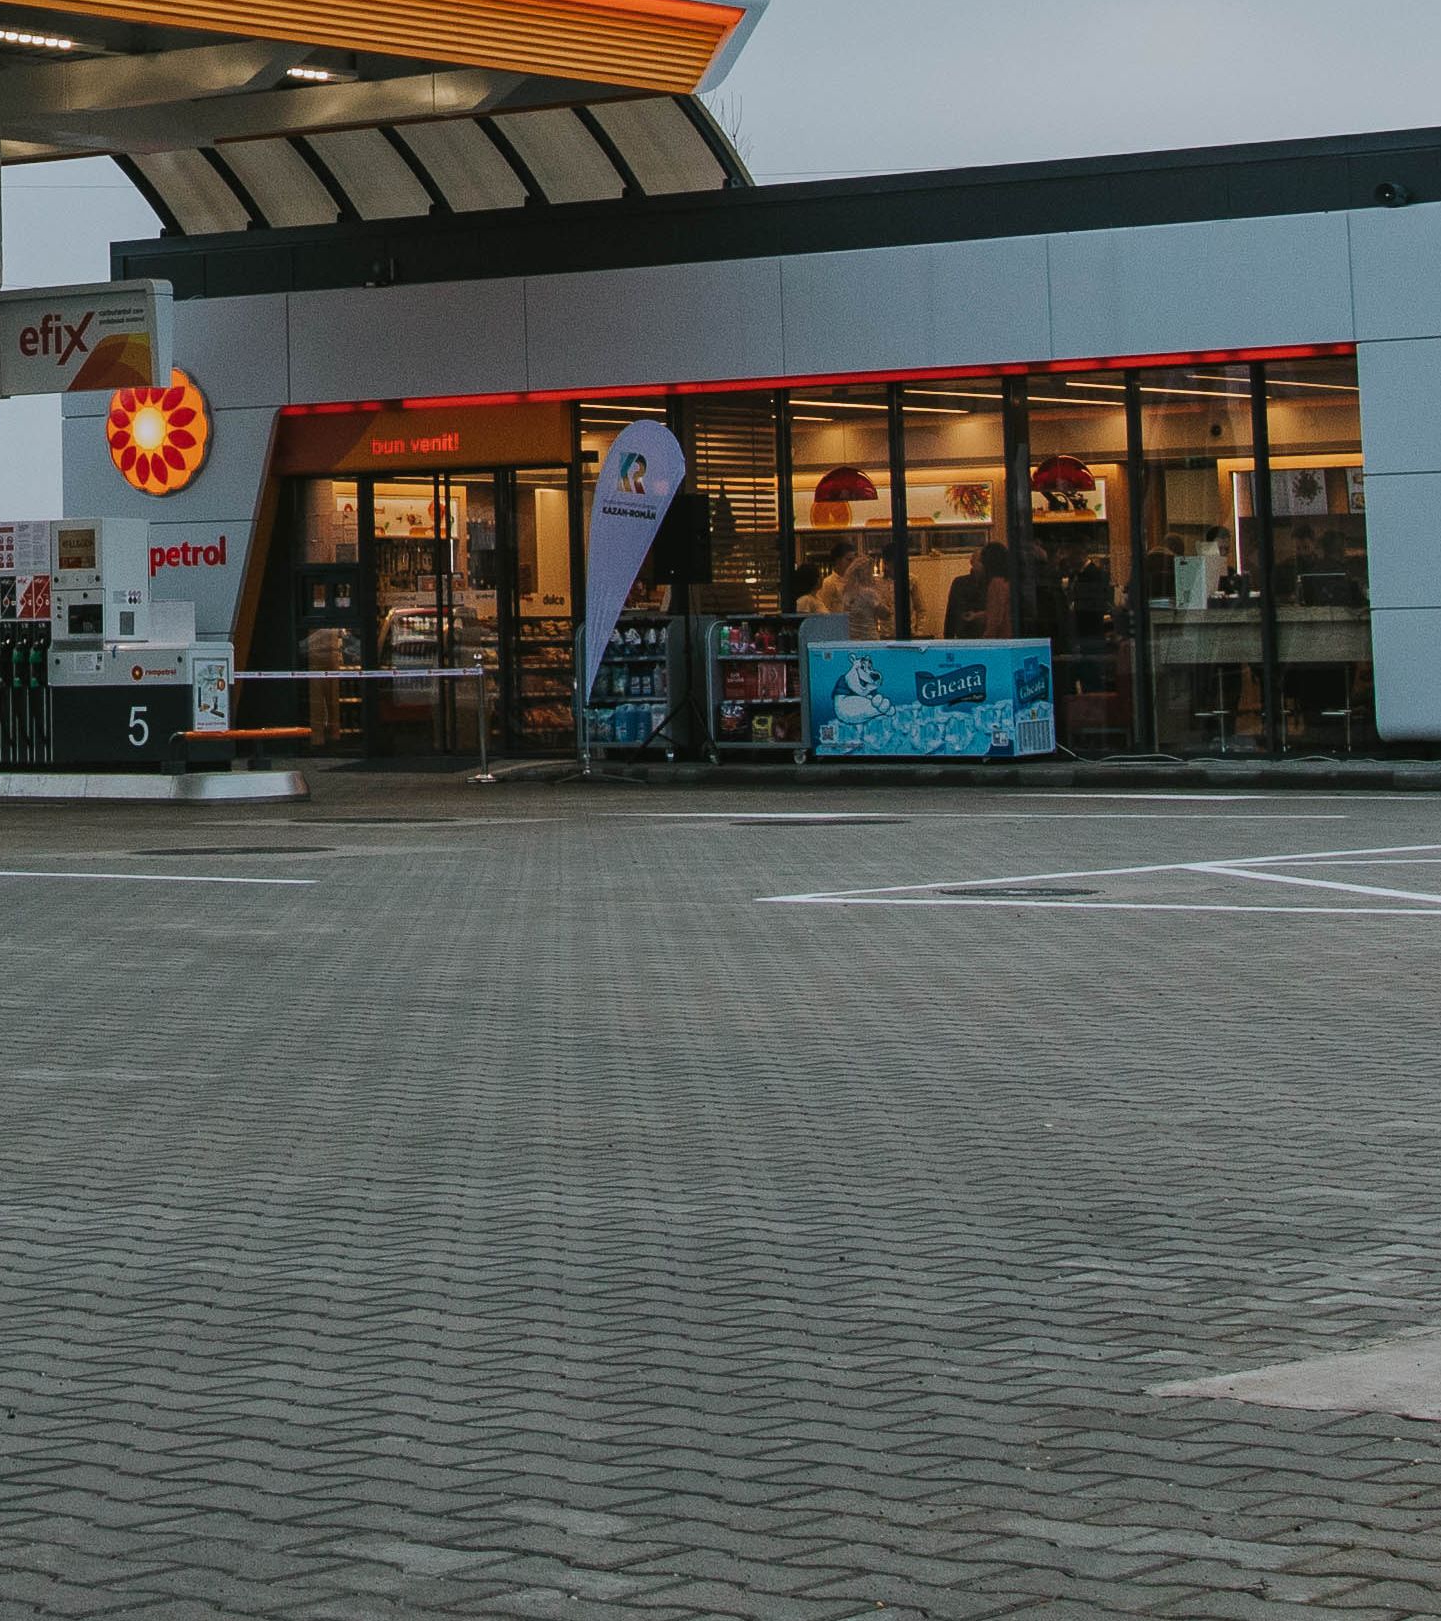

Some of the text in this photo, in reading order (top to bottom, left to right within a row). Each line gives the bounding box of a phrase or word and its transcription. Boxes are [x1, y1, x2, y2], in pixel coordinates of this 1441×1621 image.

[20, 311, 95, 366] efix
[371, 431, 460, 455] bun venit!
[149, 535, 227, 577] petrol
[543, 593, 565, 606] dulce
[145, 667, 177, 677] rompetrol
[128, 706, 149, 746] 5
